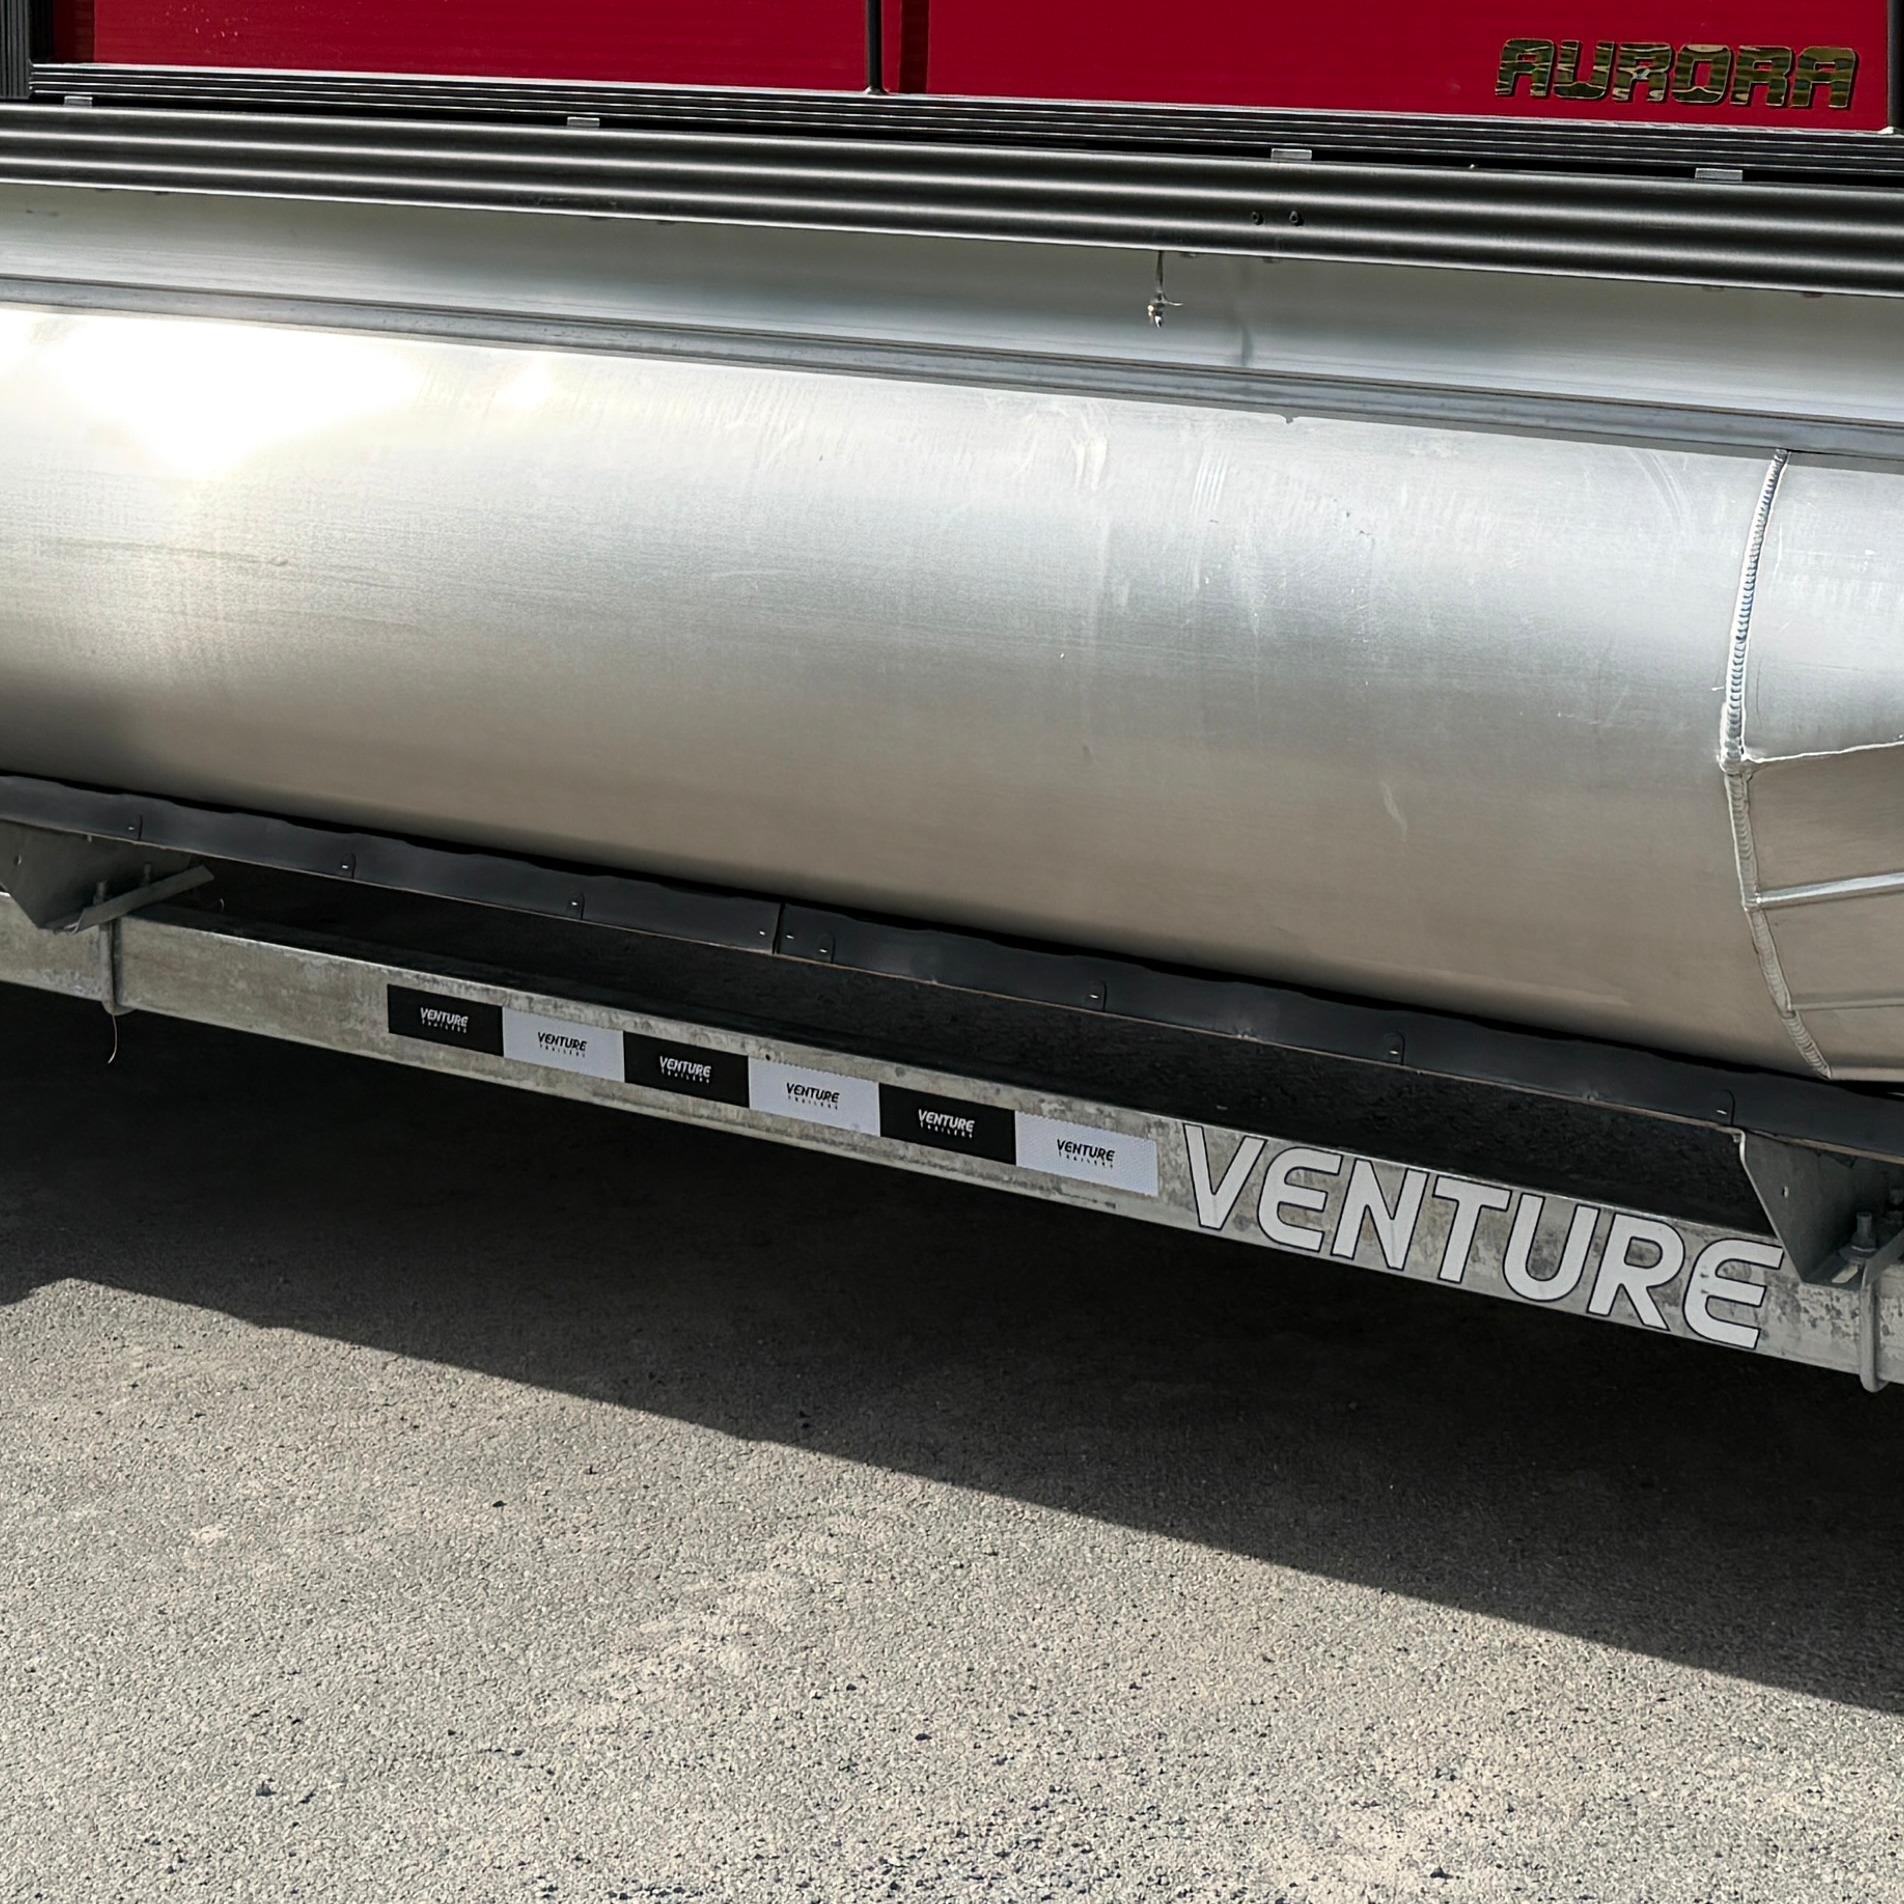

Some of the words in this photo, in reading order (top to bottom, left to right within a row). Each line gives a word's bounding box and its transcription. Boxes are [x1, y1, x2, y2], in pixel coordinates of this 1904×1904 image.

[1495, 37, 1857, 109] AURORA
[420, 1007, 469, 1027] VENTURE
[537, 1031, 588, 1051] VENTURE
[659, 1055, 712, 1078] VENTURE
[786, 1082, 840, 1104] VENTURE
[918, 1108, 975, 1132] VENTURE
[1056, 1138, 1116, 1162] VENTURE
[1182, 1124, 1788, 1349] VENTURE
